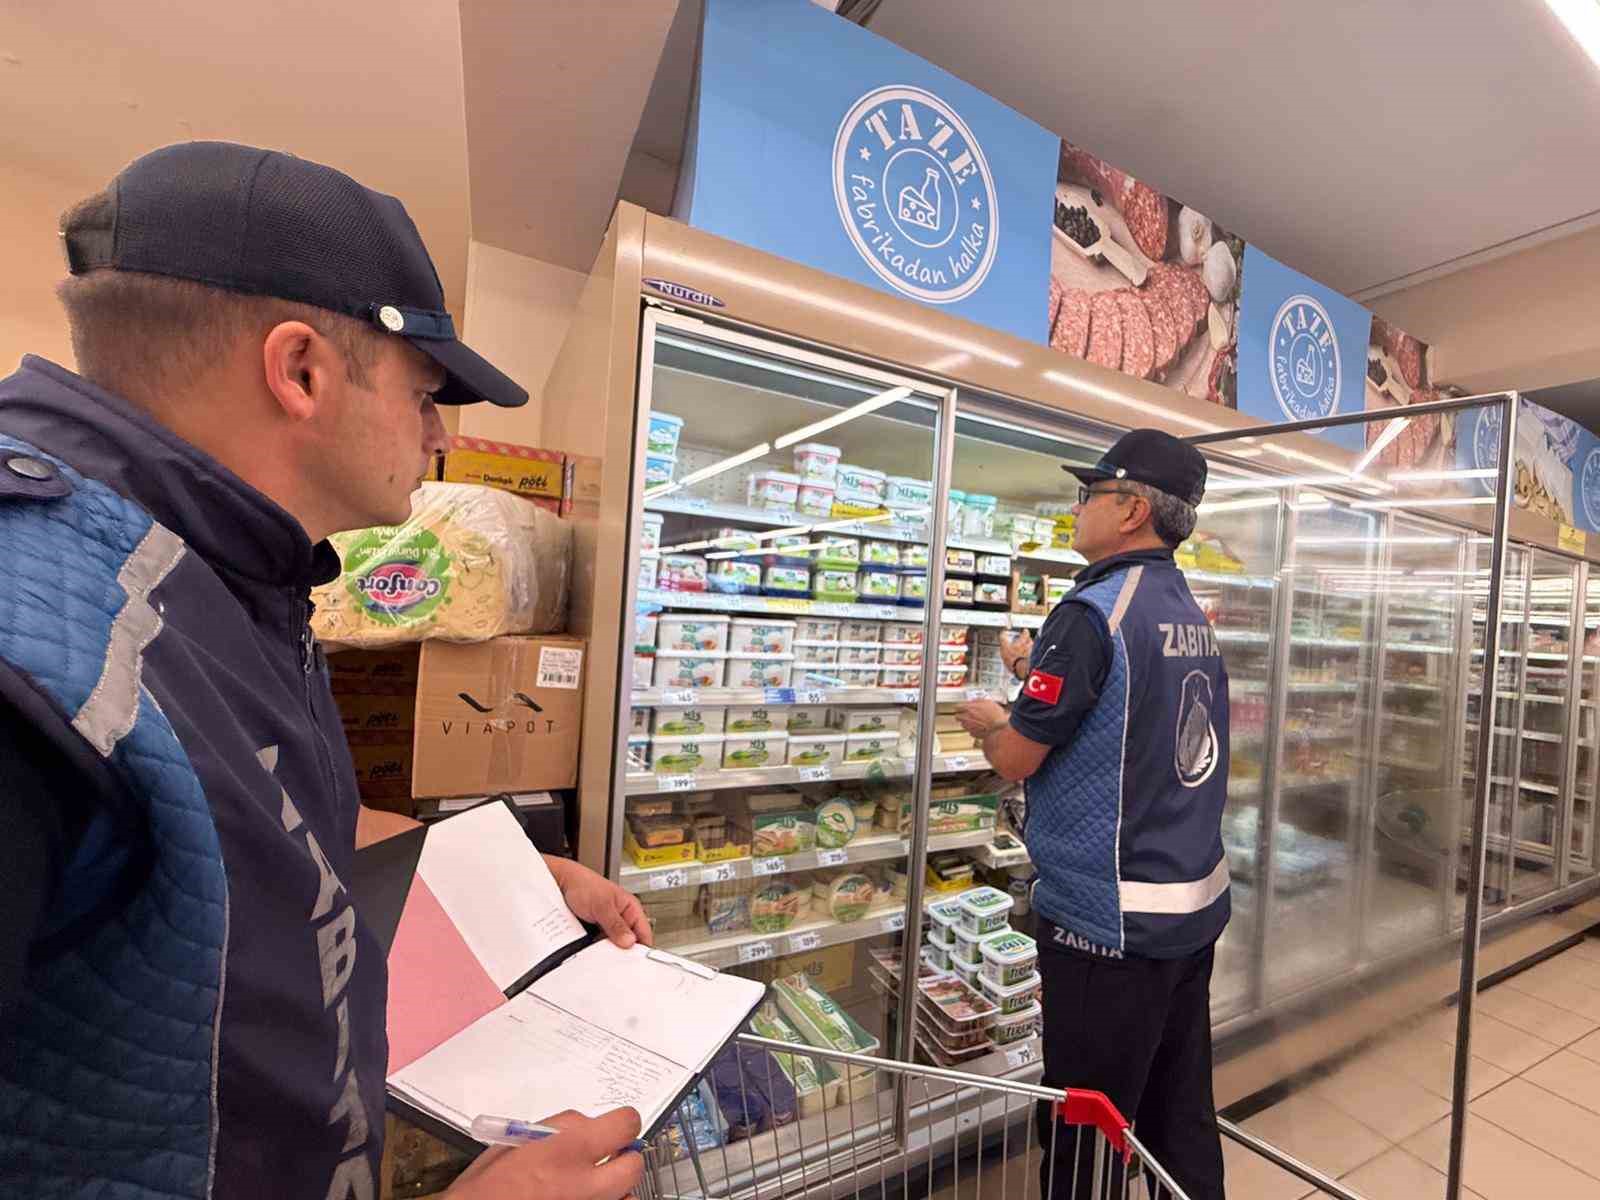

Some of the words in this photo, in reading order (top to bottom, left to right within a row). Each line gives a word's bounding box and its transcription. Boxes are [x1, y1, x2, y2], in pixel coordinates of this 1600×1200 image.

[865, 104, 977, 184] TAZE
[851, 174, 946, 284] fabrikadan
[949, 222, 984, 279] halka
[1281, 305, 1332, 352] TAZE
[1158, 623, 1221, 657] ZABITA
[666, 873, 680, 886] 92
[717, 870, 729, 880] 75
[751, 946, 766, 957] 299
